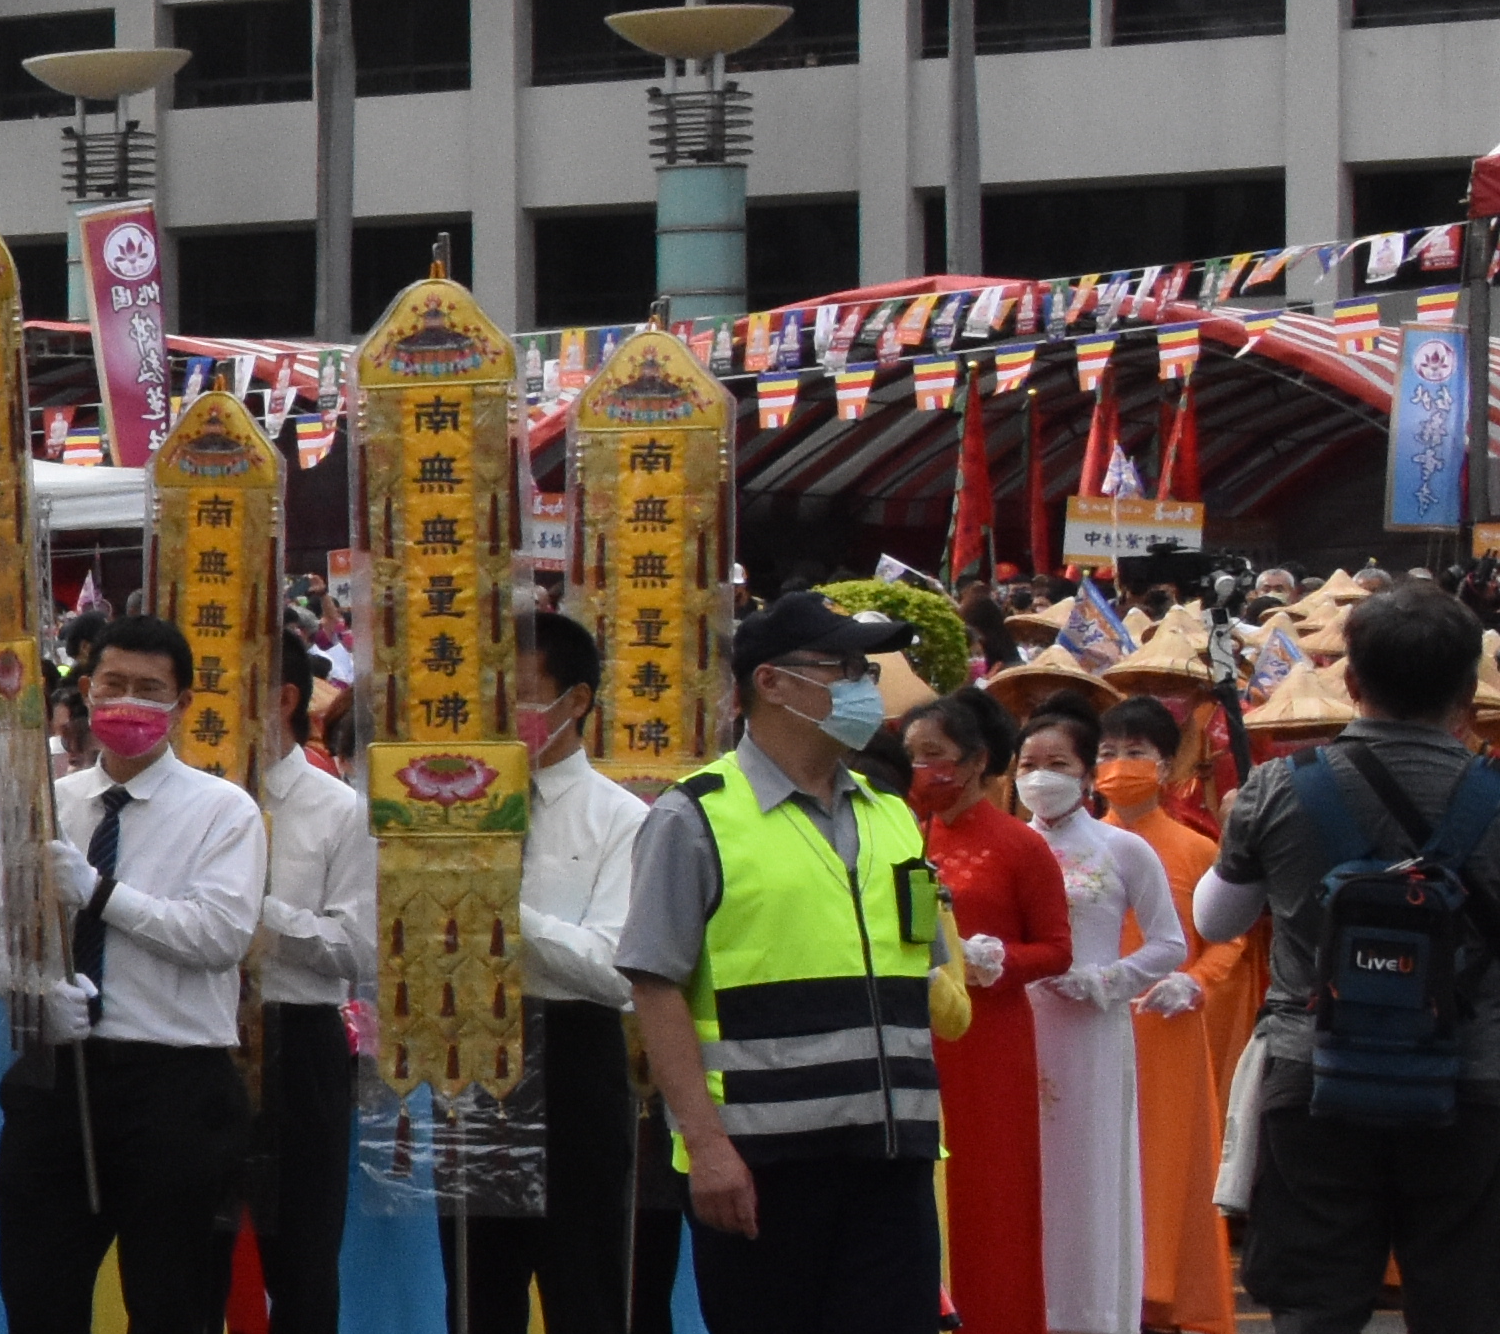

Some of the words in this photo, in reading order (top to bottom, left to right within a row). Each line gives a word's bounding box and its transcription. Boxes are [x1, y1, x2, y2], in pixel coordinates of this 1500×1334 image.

[412, 395, 471, 734] 南無無量壽佛
[623, 438, 675, 758] 南無無量壽佛
[1356, 950, 1414, 974] LiveU
